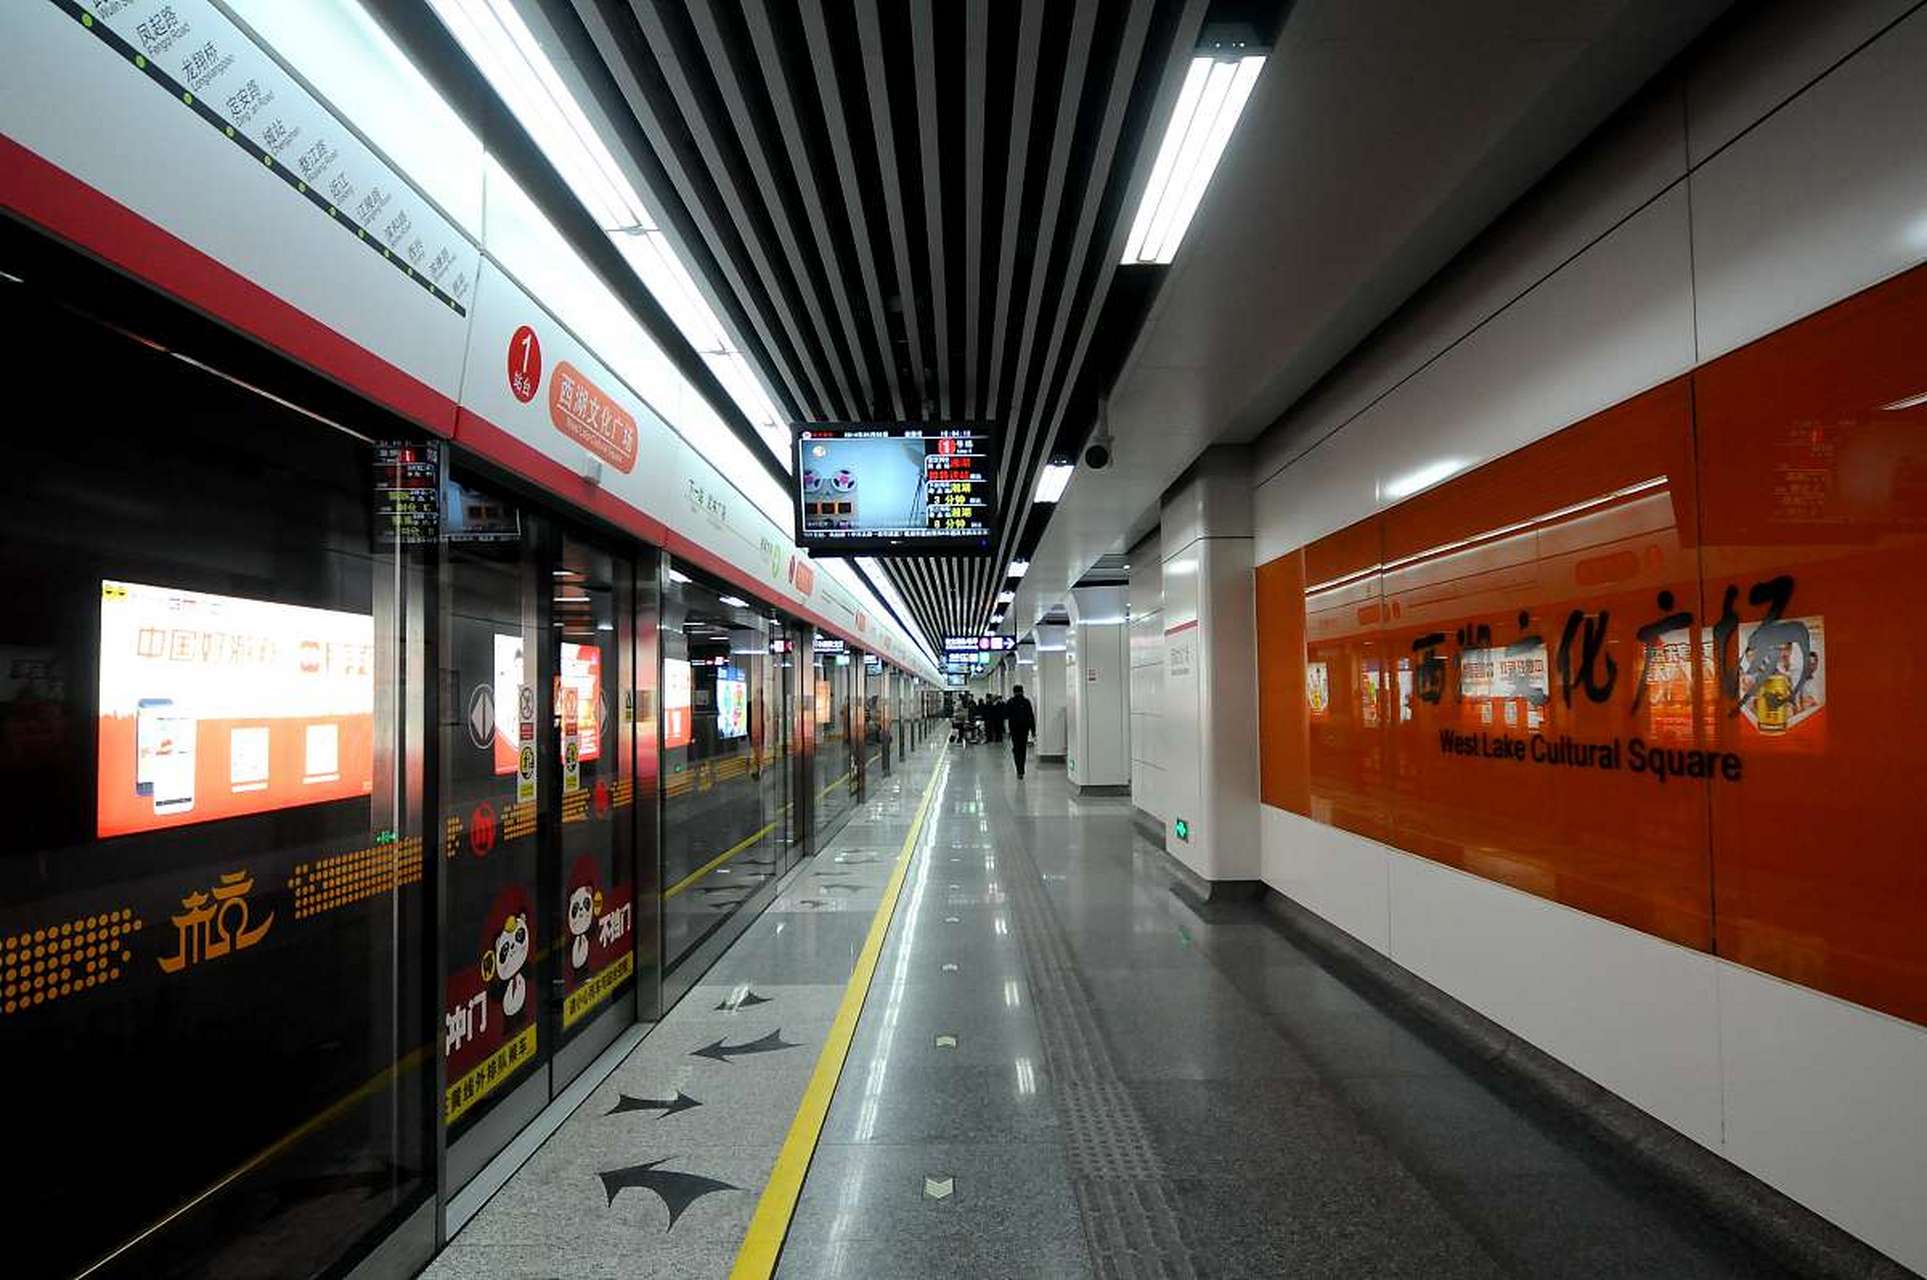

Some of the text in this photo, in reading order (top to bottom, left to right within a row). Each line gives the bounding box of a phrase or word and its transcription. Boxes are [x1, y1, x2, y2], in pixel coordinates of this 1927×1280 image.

[136, 5, 178, 48] 凤起路
[522, 333, 532, 373] 1
[560, 372, 633, 453] 西湖文化广场
[1412, 574, 1810, 717] 西湖文化广场
[1439, 729, 1743, 784] West Lake Cultural Square
